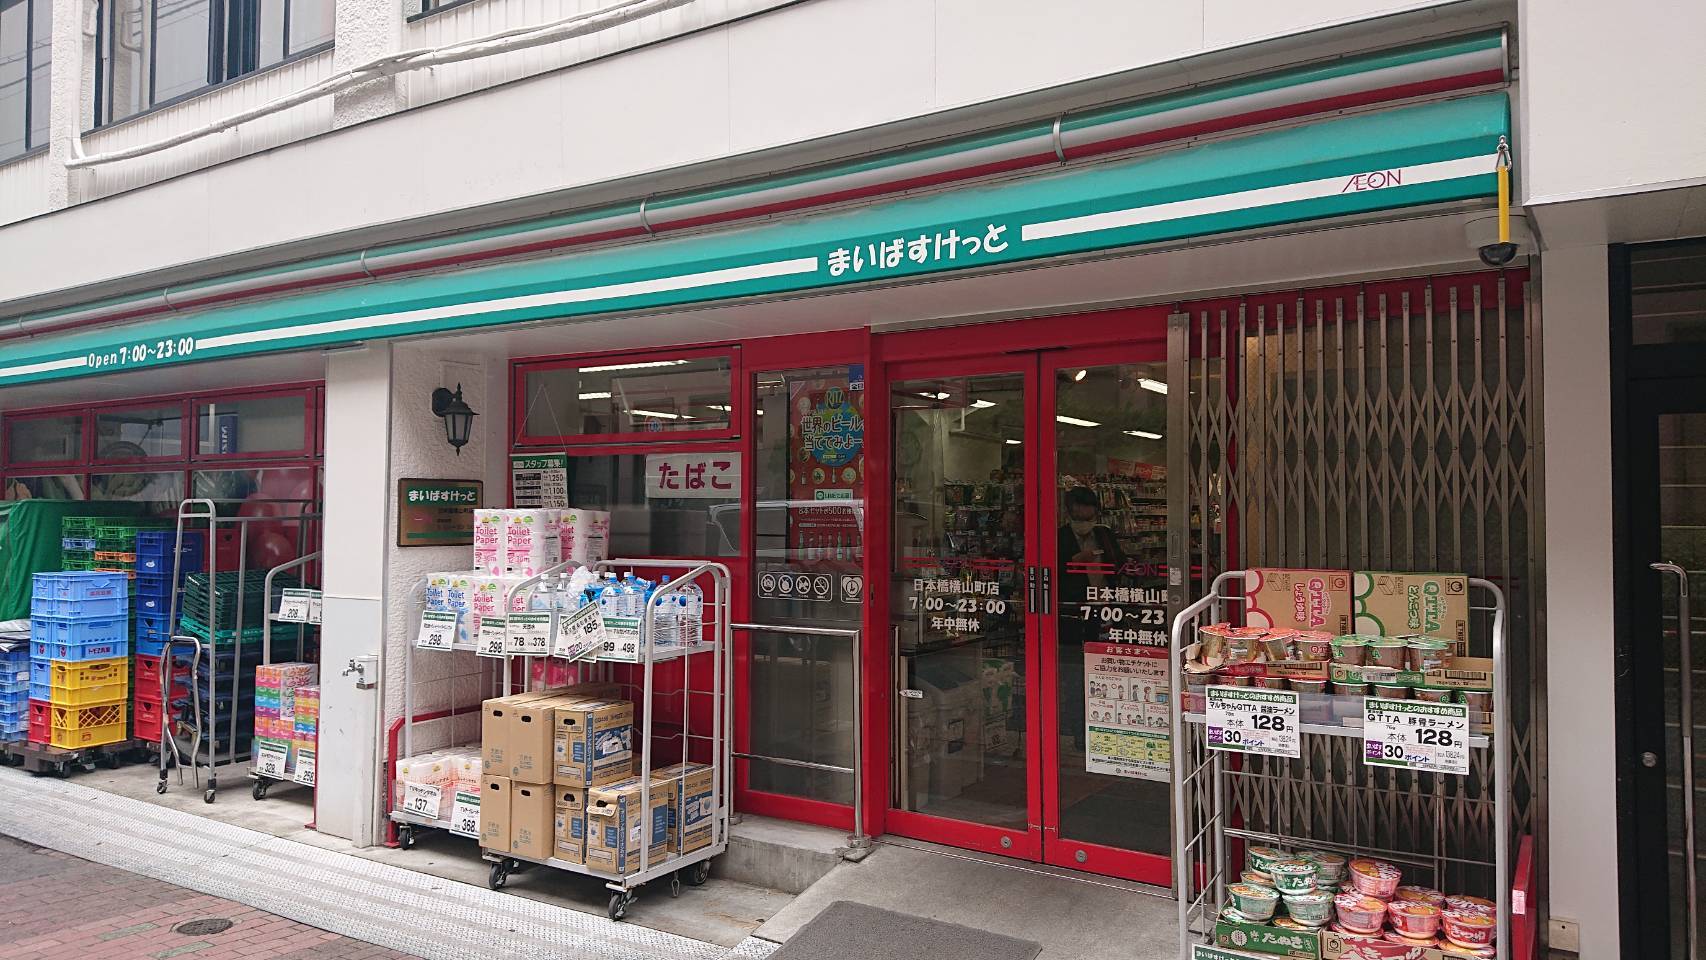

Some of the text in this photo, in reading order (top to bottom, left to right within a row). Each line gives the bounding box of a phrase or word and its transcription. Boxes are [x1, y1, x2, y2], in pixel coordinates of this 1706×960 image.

[827, 224, 1009, 277] まいばすけっと
[88, 353, 117, 368] Open
[659, 461, 732, 490] たばこ
[408, 490, 476, 502] まいばすけっと
[475, 526, 498, 535] Toilet
[507, 526, 531, 535] Toilet
[475, 536, 499, 545] Paper
[507, 536, 532, 546] Paper
[448, 589, 465, 599] Toilet
[913, 578, 1000, 596] 日本橋横山町店
[448, 598, 466, 608] Paper
[473, 593, 494, 603] Toilet
[1294, 582, 1306, 622] しょうゆ味
[1308, 578, 1325, 628] QTTA
[473, 602, 495, 612] Paper
[1408, 585, 1421, 629] とんこつ味
[1423, 581, 1440, 634] QTTA
[583, 620, 598, 635] 185
[931, 616, 980, 632] 年中無休
[513, 637, 546, 647] 78 378
[1108, 628, 1168, 646] 年中無休
[603, 642, 635, 653] 99 498
[1106, 646, 1151, 656] お客さまへ
[1101, 657, 1158, 668] お買い物エチケットに
[1210, 690, 1294, 703] まいばすけっとのおすすめ商品
[1209, 701, 1258, 712] マルちゃんQTTA
[1368, 701, 1463, 716] まいばすけっとのおすすめ商品
[1227, 714, 1294, 733] 本体 128 円
[1367, 713, 1465, 729] QTTA 豚骨ラーメン
[1224, 730, 1265, 747] 30 ポイント
[1387, 728, 1462, 748] 本体 128 円
[1384, 744, 1430, 763] 30 ポイント
[415, 797, 428, 812] 137
[461, 819, 476, 833] 368
[1262, 931, 1304, 950] たぬき
